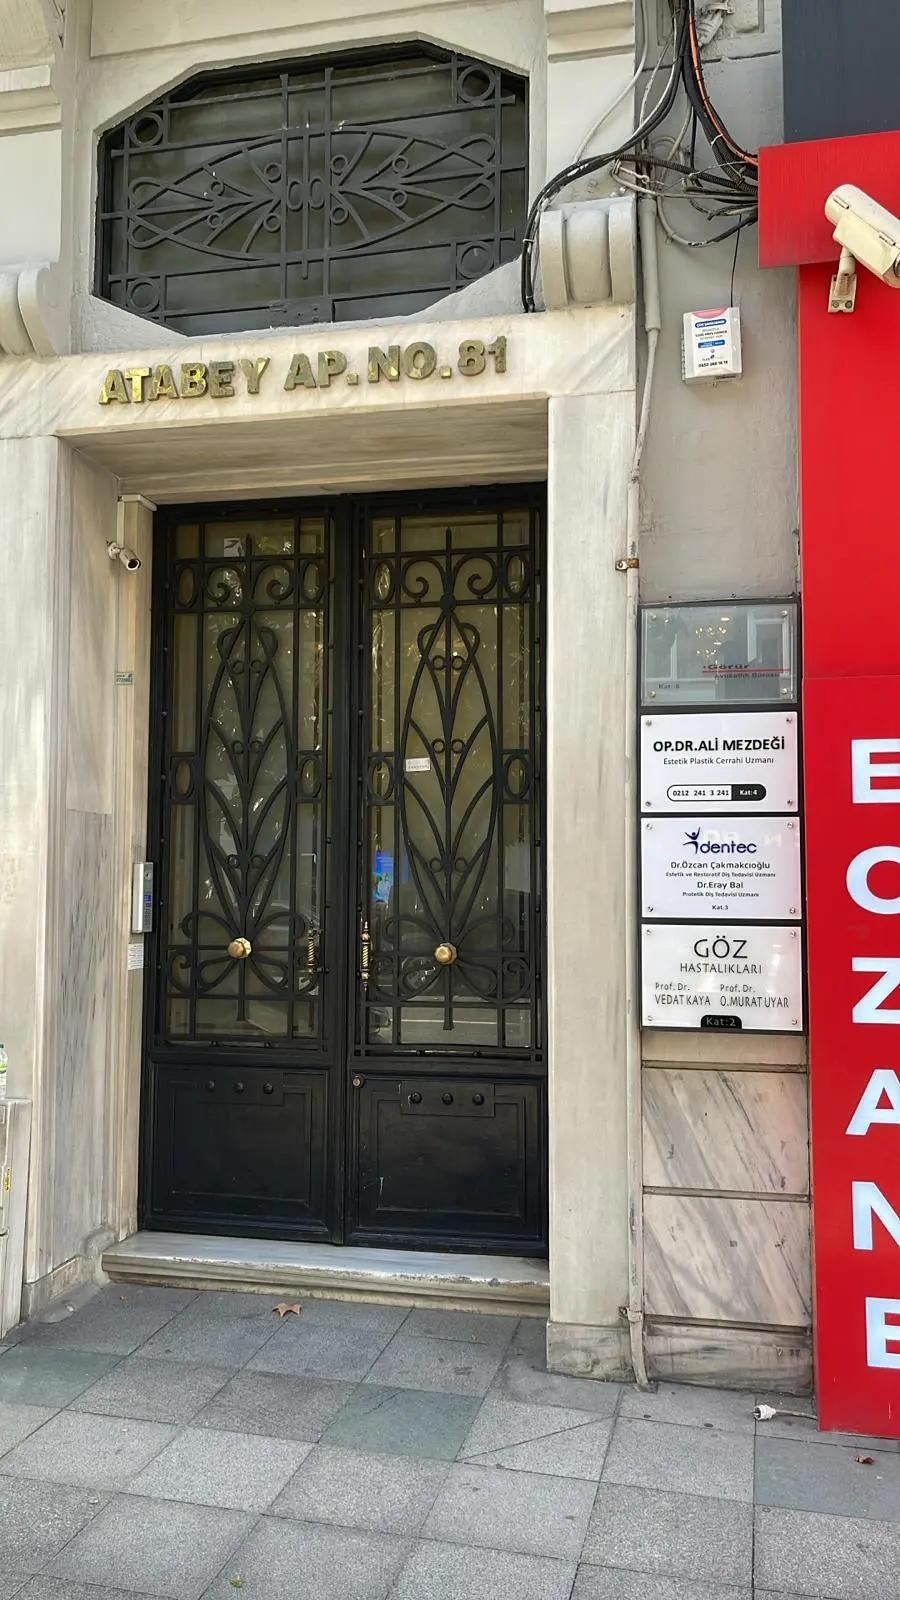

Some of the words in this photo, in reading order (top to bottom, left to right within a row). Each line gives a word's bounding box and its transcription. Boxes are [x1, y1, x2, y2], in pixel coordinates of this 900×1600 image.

[98, 357, 270, 404] ATABEY
[653, 738, 719, 752] OP.DR.ALİ
[723, 736, 785, 751] MEZDEĞİ
[663, 757, 688, 765] Estetik
[671, 861, 708, 869] Dr.Özcan
[697, 882, 727, 890] Dr.Eray
[694, 935, 748, 959] GÖZ
[680, 963, 762, 974] HASTALIKLARI
[655, 982, 677, 991] Prof.
[678, 983, 690, 991] Dr.
[720, 984, 741, 992] Prof.
[743, 985, 755, 993] Dr.
[655, 994, 685, 1006] VEDAT
[687, 995, 711, 1006] KAYA
[764, 997, 789, 1008] UYAR
[706, 1017, 737, 1027] Kat:2
